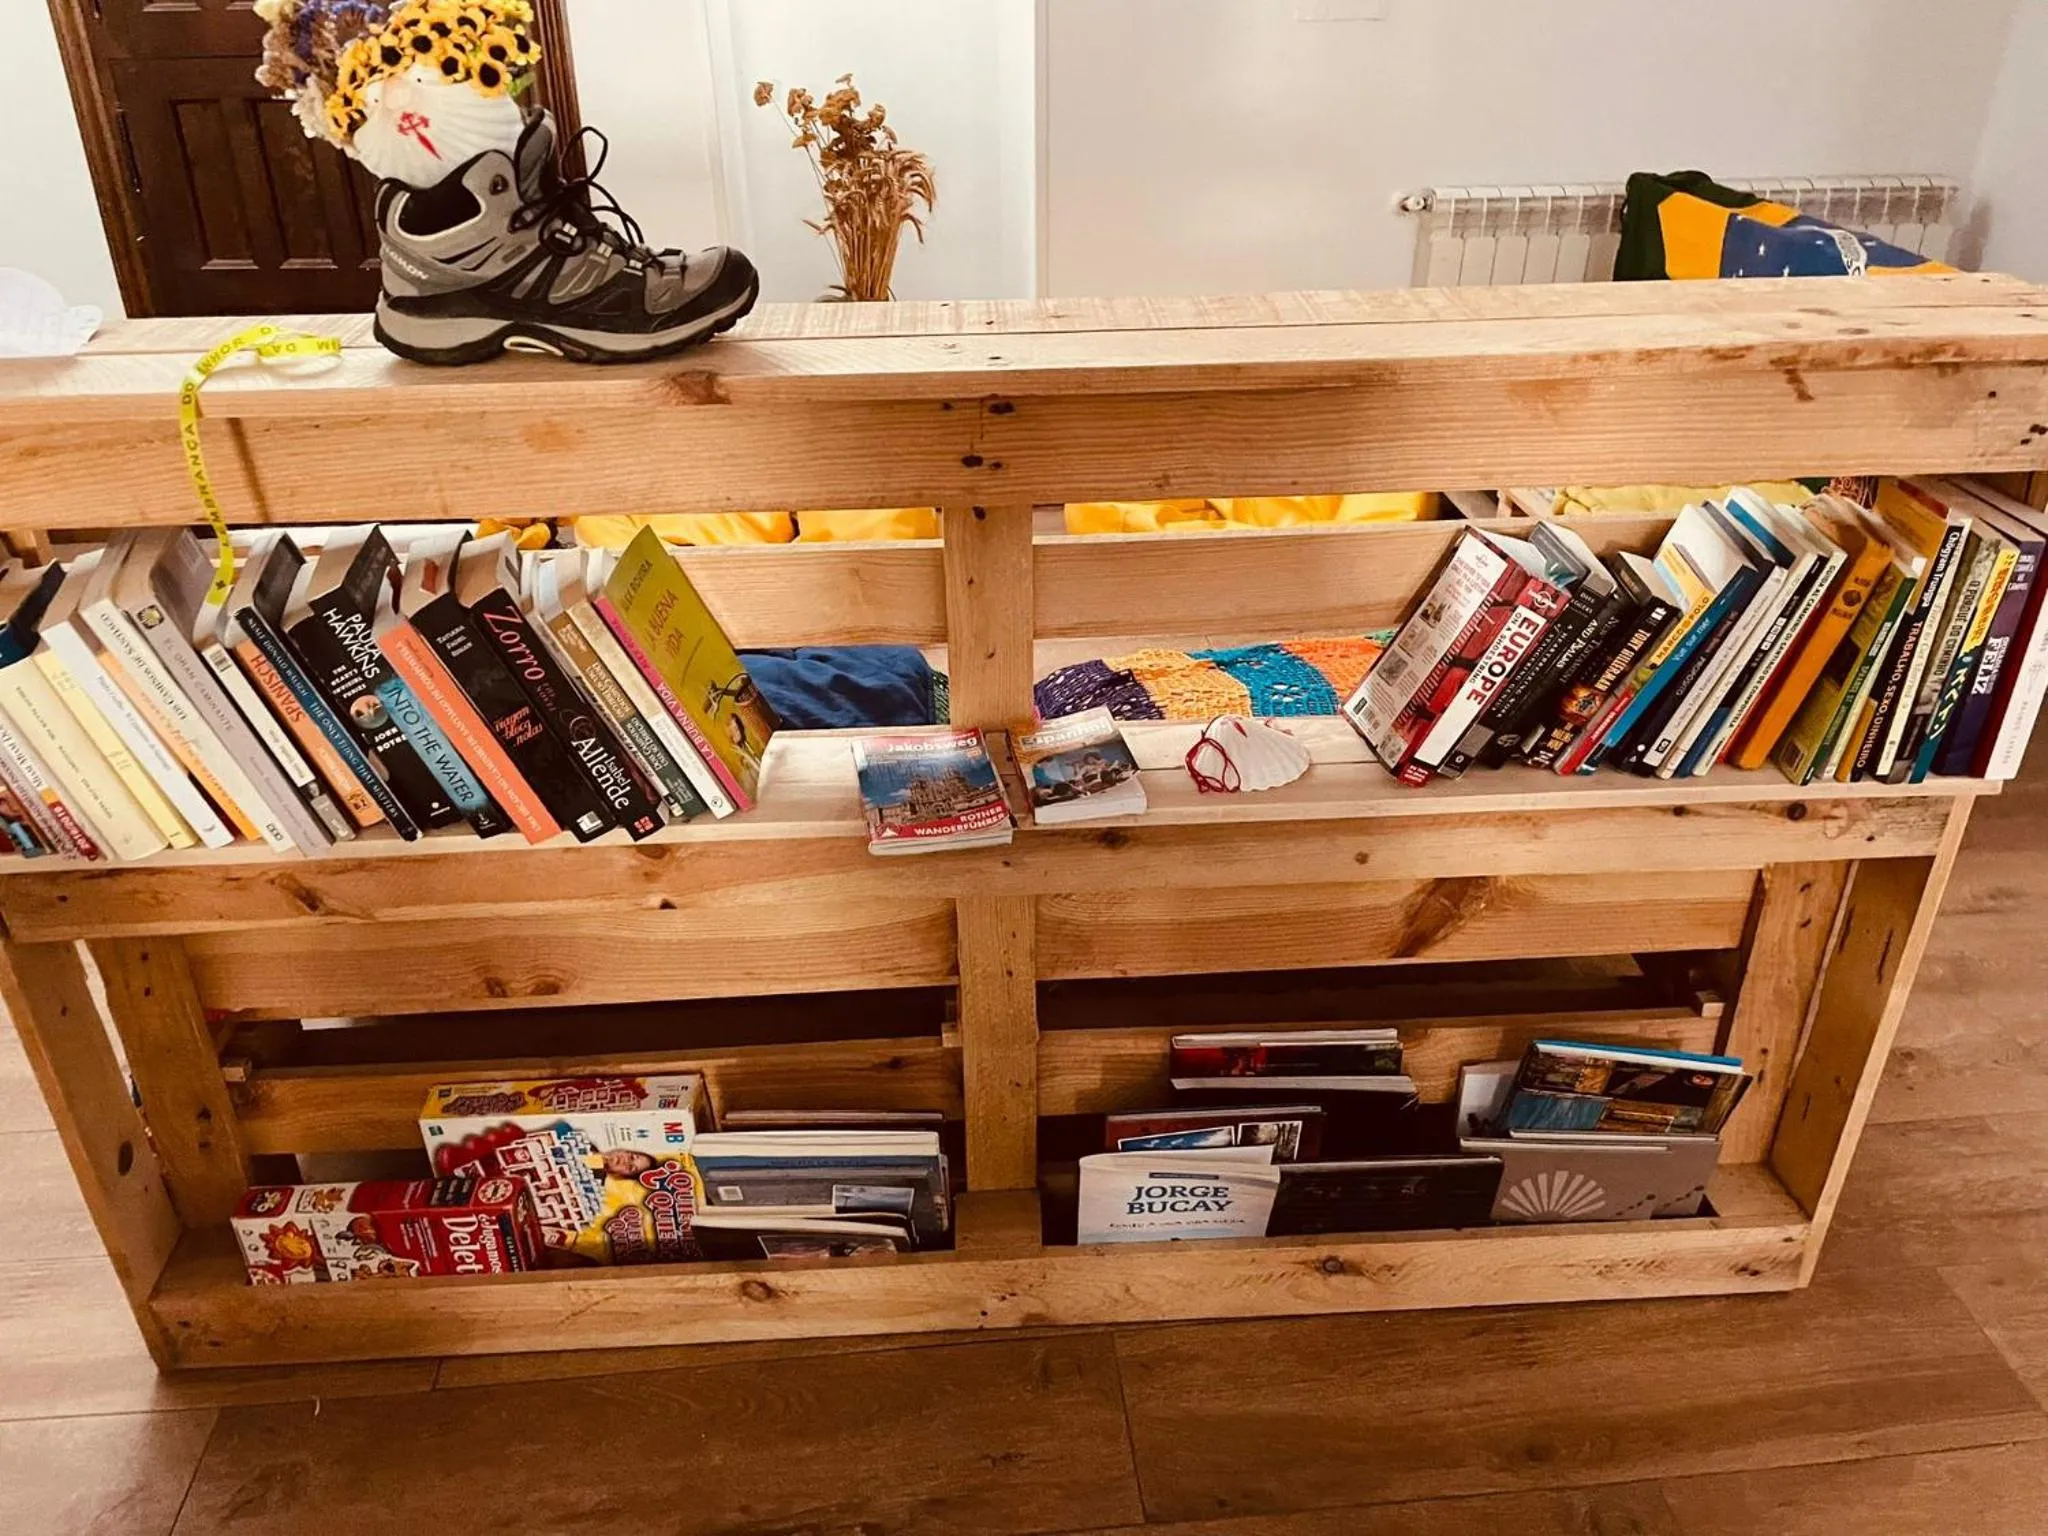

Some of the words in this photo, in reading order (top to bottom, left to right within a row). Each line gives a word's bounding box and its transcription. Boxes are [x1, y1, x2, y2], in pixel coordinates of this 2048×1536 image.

[1816, 562, 1837, 588] GUIDA
[1919, 570, 1943, 610] Trungpa
[1508, 610, 1523, 626] ON
[1579, 616, 1599, 639] AND
[1655, 624, 1685, 662] MARCO
[1686, 592, 1711, 622] POLO
[1787, 595, 1815, 634] CAMMINO
[318, 604, 384, 681] HAWKINS
[342, 610, 388, 662] PAULA
[477, 595, 558, 687] Zorro
[1513, 628, 1555, 683] STAGGERING
[1554, 634, 1586, 672] PSALMS
[1624, 624, 1652, 654] TONY
[1887, 617, 1922, 688] TRABALHO,
[1464, 614, 1540, 709] EUROPE
[1466, 631, 1508, 685] SHOESTRING
[1513, 627, 1568, 701] HEARTBREAKING
[1558, 635, 1601, 689] TESTAMENT
[1593, 644, 1634, 694] HILLERMAN
[1760, 639, 1787, 676] SANTIAGO
[1932, 635, 1957, 679] CAMINHO
[1970, 633, 2002, 698] FELIZ
[246, 651, 309, 725] SPANISCH
[653, 680, 679, 709] VIDA
[1495, 695, 1517, 721] WORK
[1725, 683, 1759, 730] COMPOSTELA
[372, 722, 399, 746] JOHN
[378, 680, 422, 729] INTO
[410, 723, 445, 760] THE
[430, 752, 477, 805] WATER
[672, 706, 706, 746] BUENA
[886, 735, 978, 753] Jakobsweg
[1855, 714, 1883, 770] DINHEIRO
[308, 700, 327, 720] THE
[319, 716, 342, 740] ONLY
[335, 736, 361, 766] THING
[355, 763, 375, 786] THAT
[368, 781, 401, 819] MATTERS
[567, 727, 641, 813] Allende
[601, 754, 633, 788] Isabel
[698, 742, 716, 761] LA
[913, 812, 1006, 837] WANDERFÜHRER
[959, 805, 1004, 823] ROTHER
[663, 1122, 685, 1142] MB
[1126, 1199, 1234, 1214] BUCAY
[1132, 1185, 1229, 1201] JORGE
